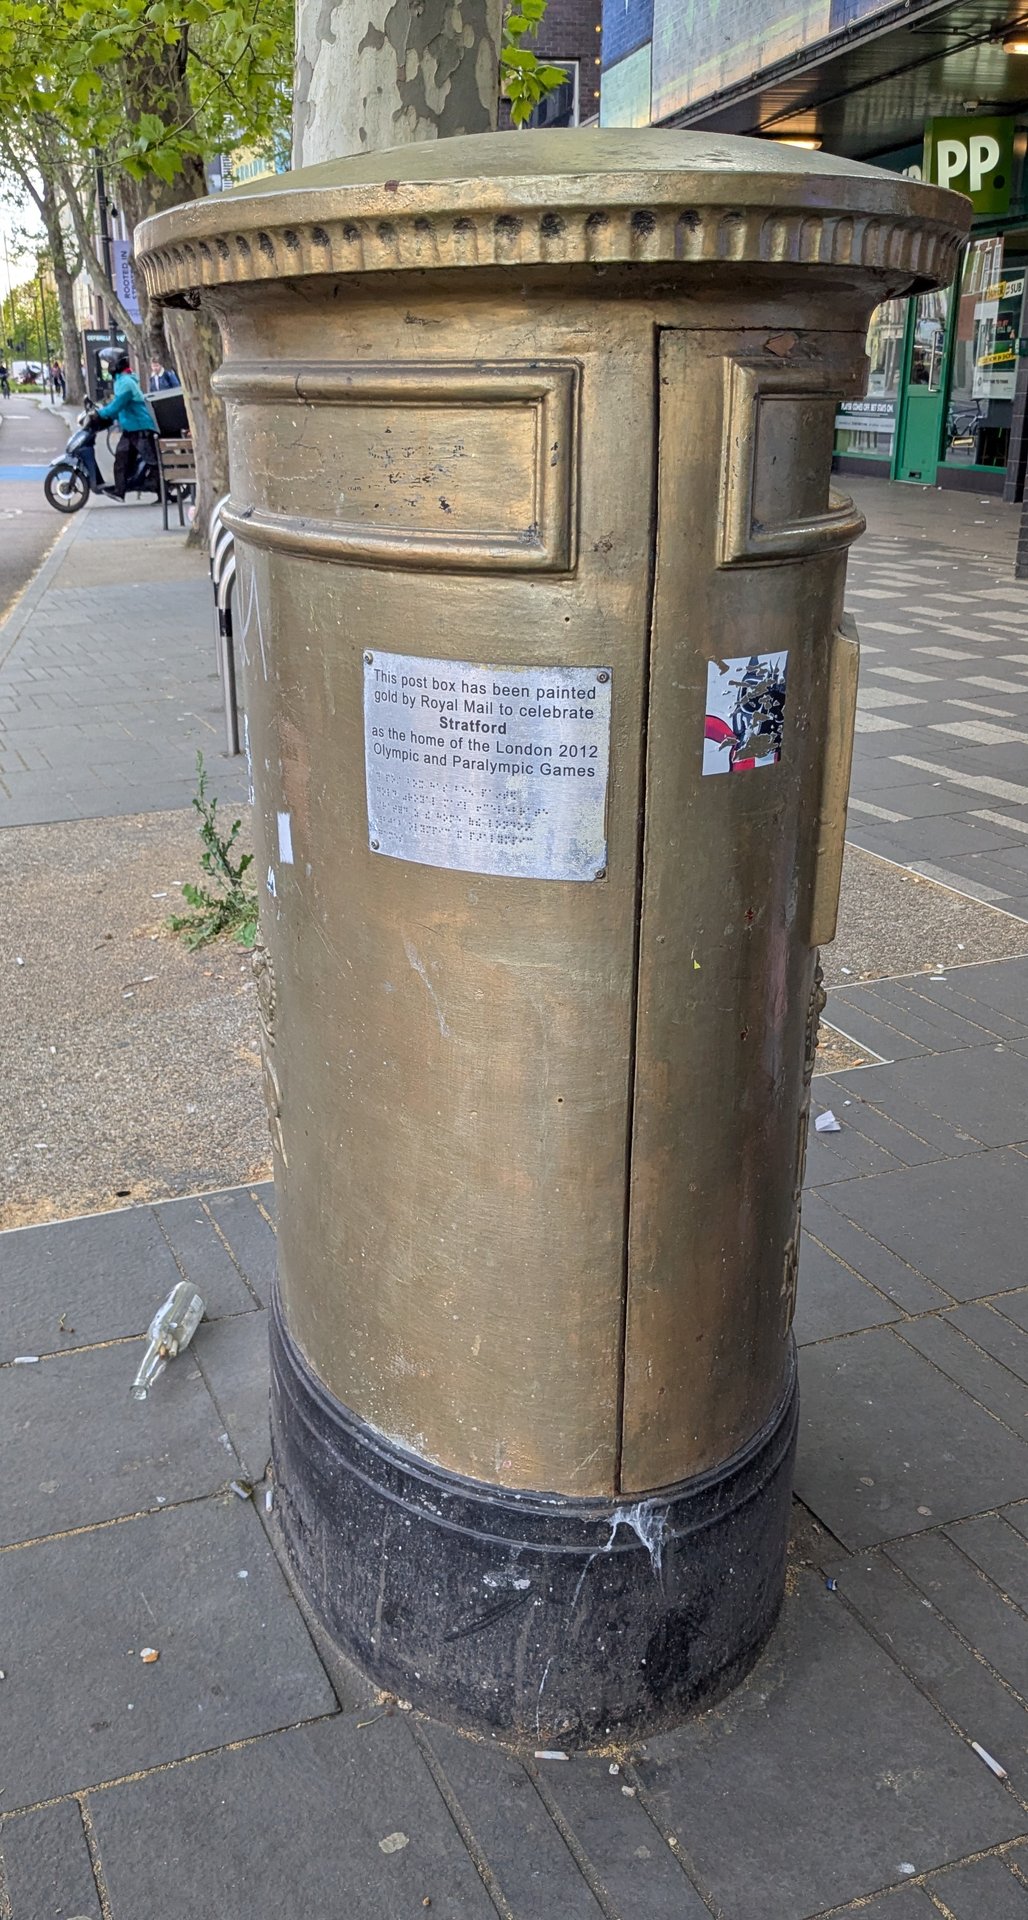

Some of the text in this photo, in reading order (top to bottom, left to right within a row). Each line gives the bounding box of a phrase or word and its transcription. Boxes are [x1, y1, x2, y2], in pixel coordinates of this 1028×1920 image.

[121, 250, 131, 299] ROOTED IN
[374, 669, 596, 700] This post box has been painted
[374, 689, 594, 719] gold by Royal Mail to celebrate
[439, 717, 507, 735] Stratford
[372, 727, 598, 758] as the home of the London 2012
[374, 743, 595, 777] Olympic and Paralympic Games
